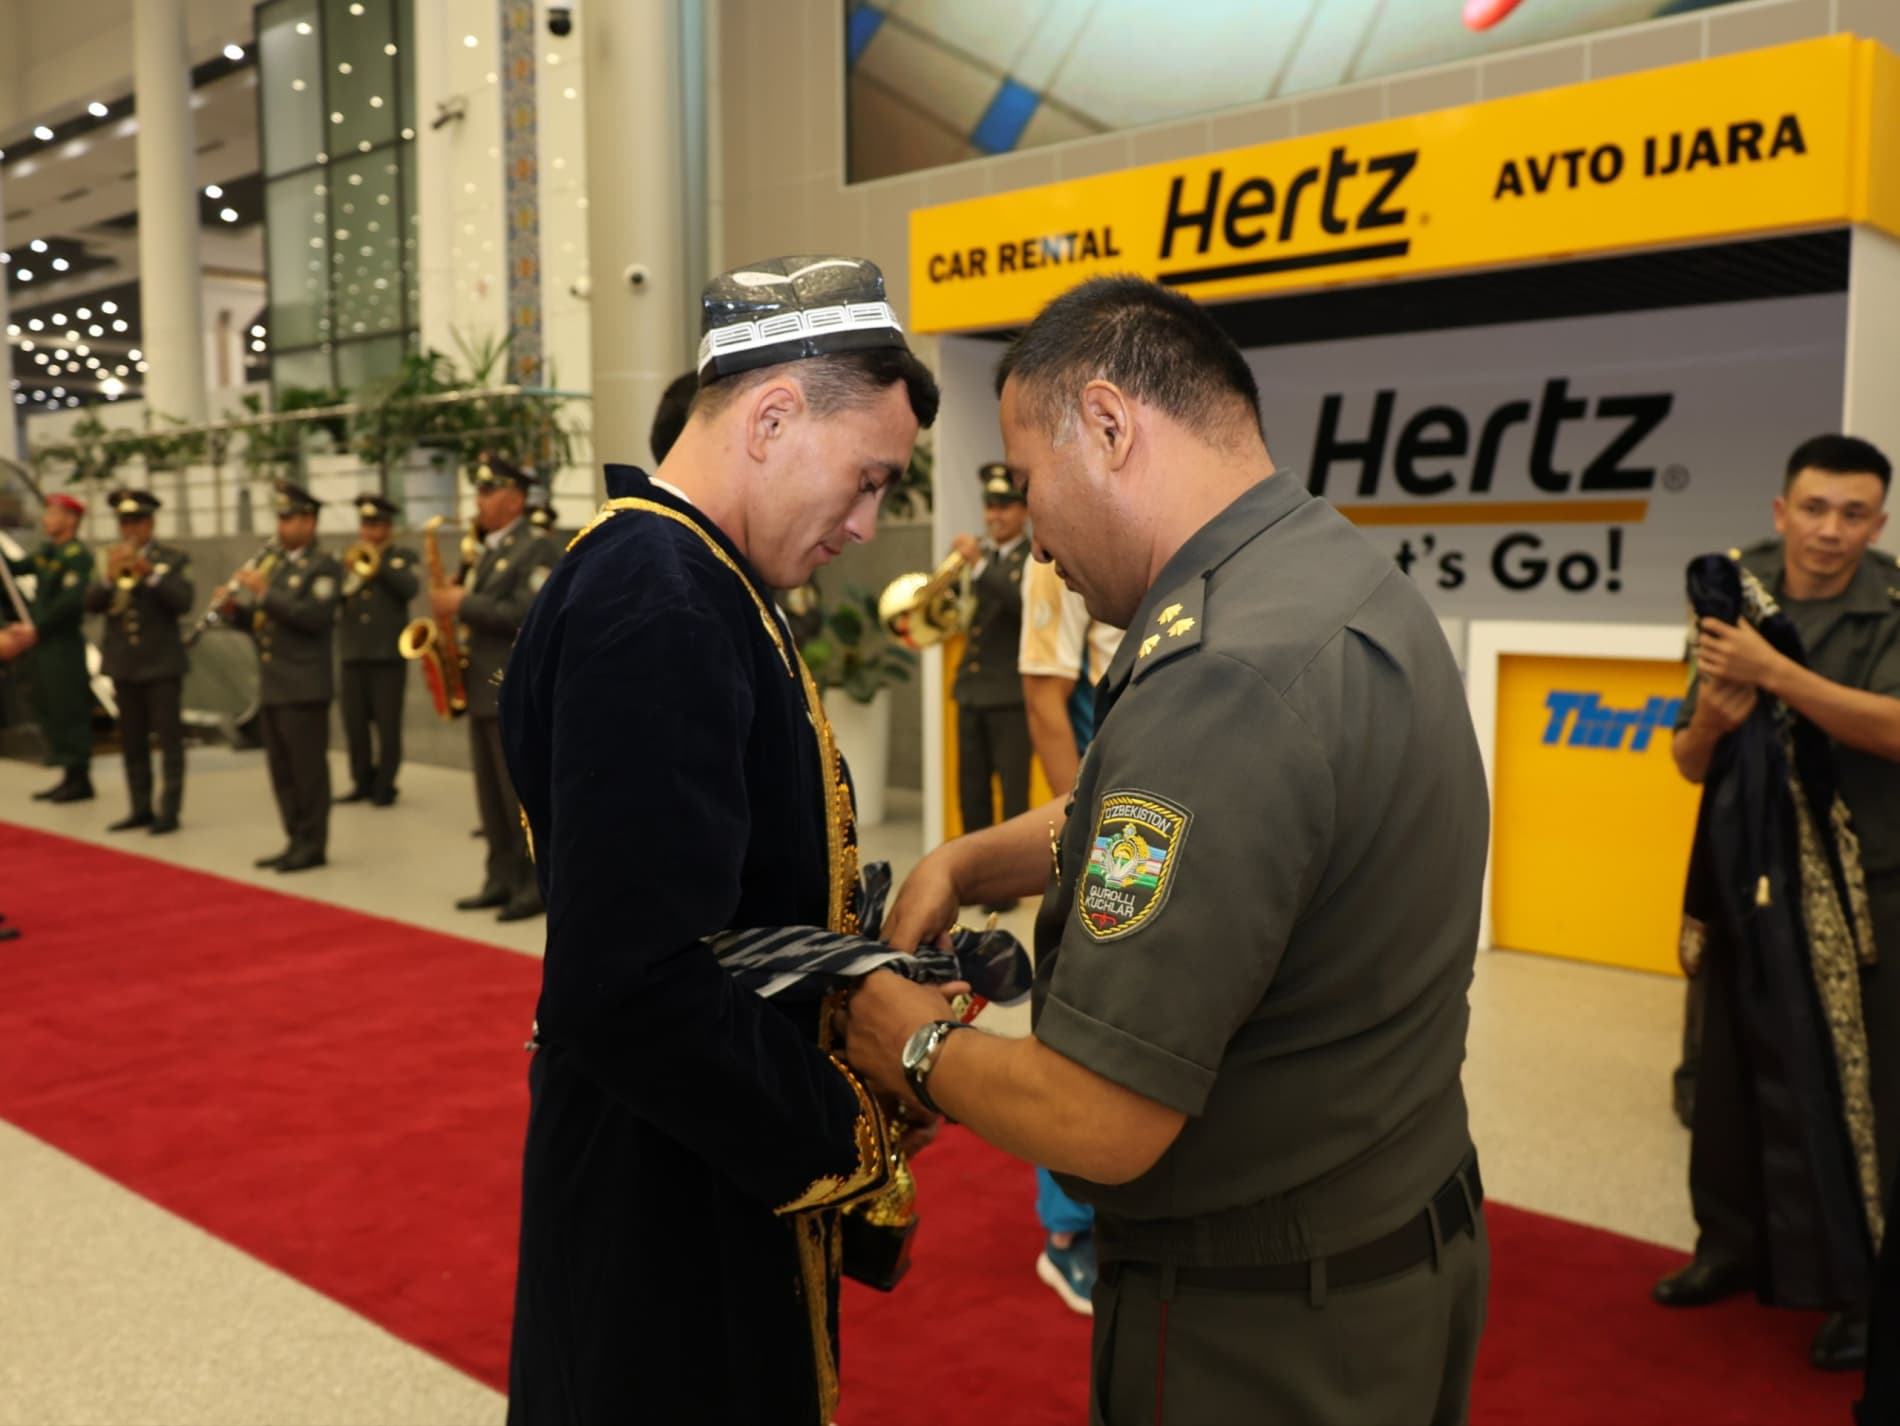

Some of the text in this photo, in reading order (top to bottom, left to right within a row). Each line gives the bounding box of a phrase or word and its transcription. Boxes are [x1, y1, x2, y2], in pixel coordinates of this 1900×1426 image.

[1493, 112, 1807, 200] AVTO IJARA
[1158, 145, 1419, 259] Hertz
[928, 226, 1121, 284] CAR RENTAL
[1307, 377, 1675, 497] Hertz
[1394, 526, 1624, 593] t's Go!
[1085, 896, 1135, 918] KUCHLAR
